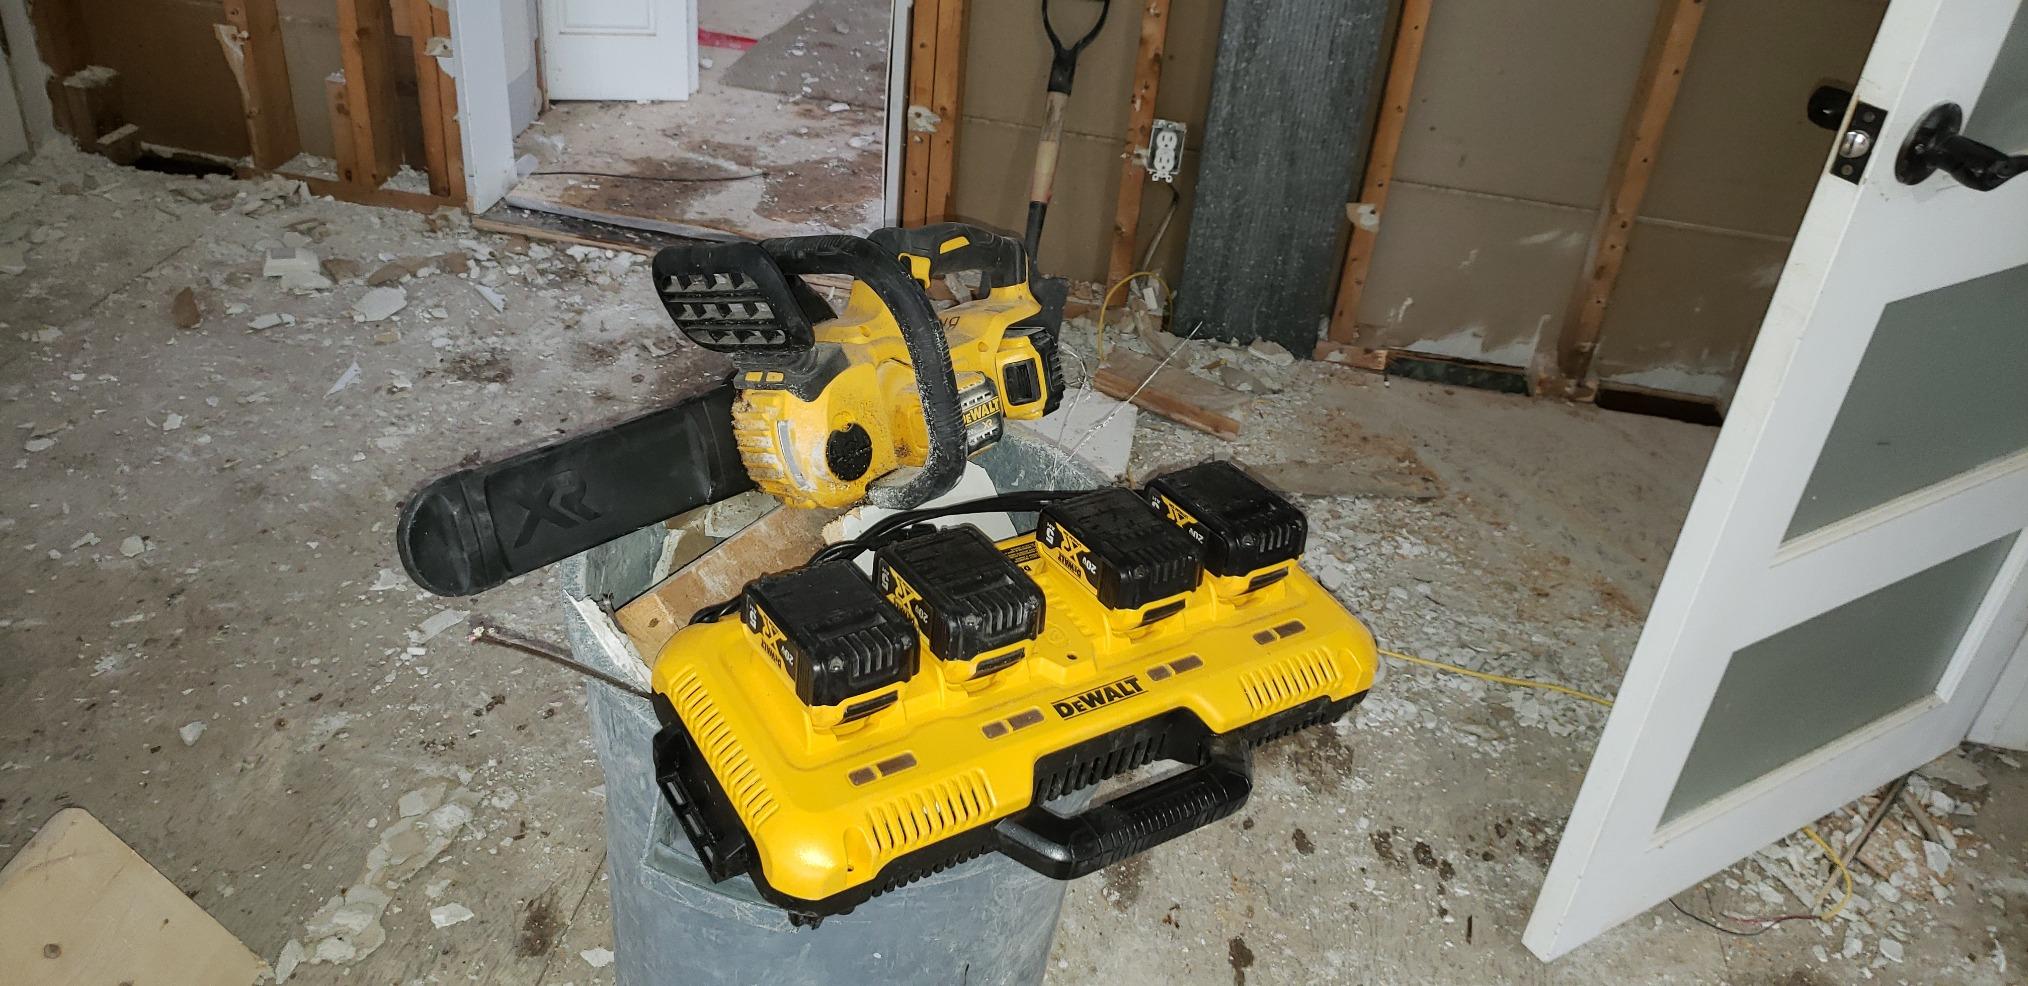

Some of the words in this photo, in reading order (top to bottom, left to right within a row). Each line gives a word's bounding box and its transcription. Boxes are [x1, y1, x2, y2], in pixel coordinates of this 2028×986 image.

[514, 469, 601, 549] XR
[1081, 556, 1097, 575] 20V
[1052, 677, 1144, 719] DEWALT
